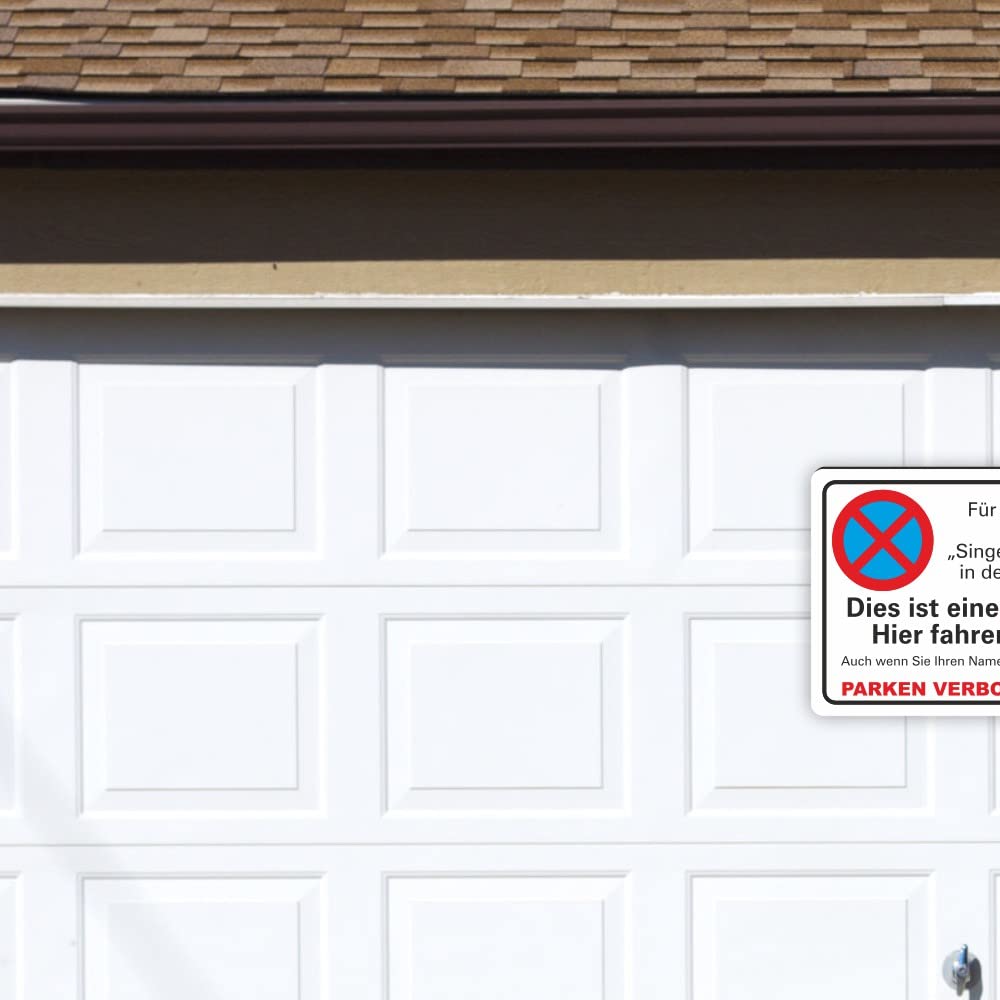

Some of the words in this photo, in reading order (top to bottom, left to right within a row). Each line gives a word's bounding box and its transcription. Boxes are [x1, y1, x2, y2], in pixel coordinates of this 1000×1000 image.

[969, 501, 996, 517] Für
[960, 564, 974, 579] in
[847, 597, 900, 618] Dies
[909, 597, 939, 618] ist
[947, 597, 999, 618] eine
[872, 624, 923, 645] Hier
[841, 656, 871, 667] Auch
[875, 658, 909, 667] wenn
[912, 656, 931, 667] Sie
[934, 656, 965, 667] Ihren
[841, 681, 926, 697] PARKEN
